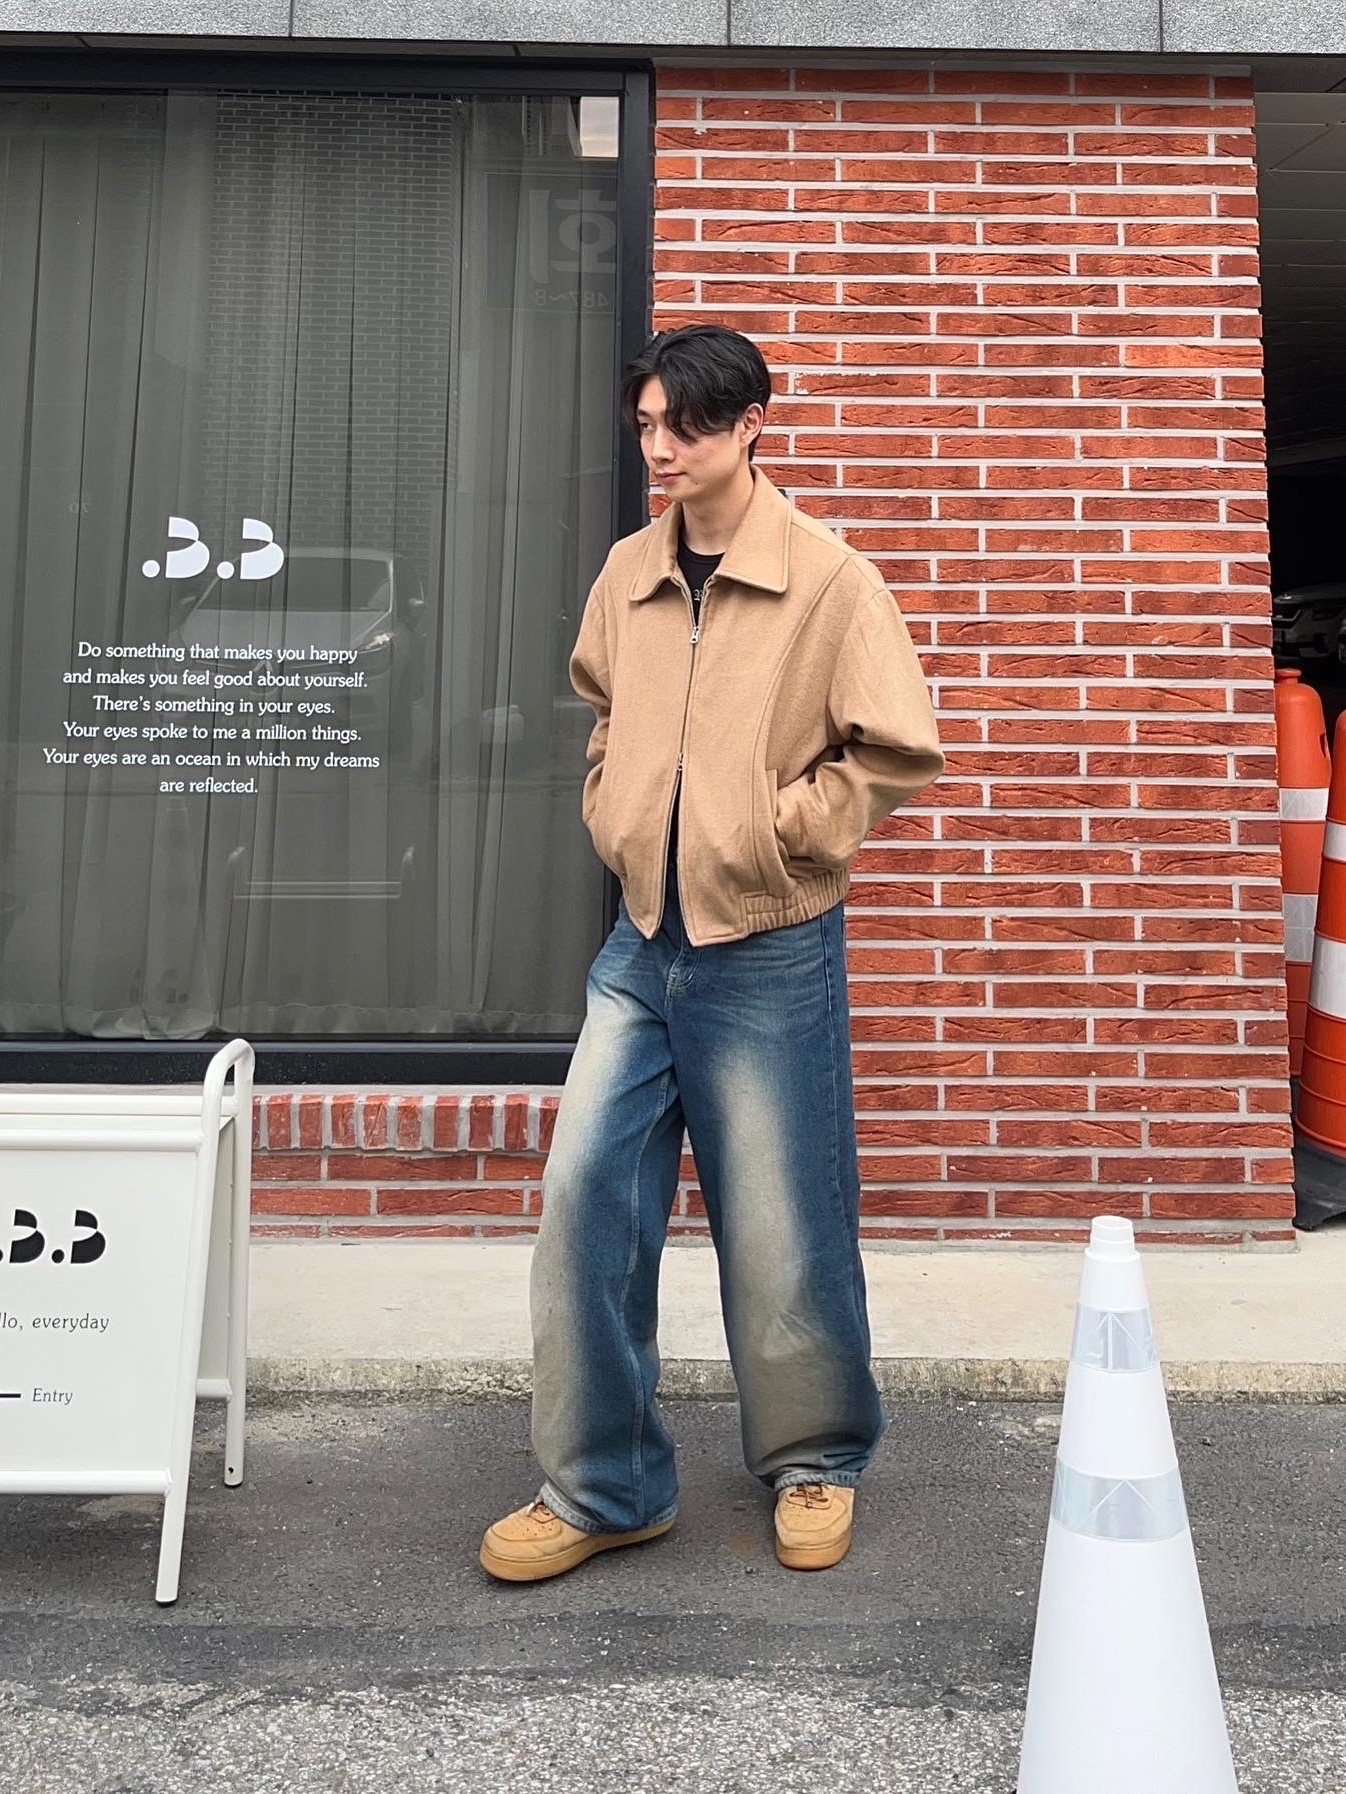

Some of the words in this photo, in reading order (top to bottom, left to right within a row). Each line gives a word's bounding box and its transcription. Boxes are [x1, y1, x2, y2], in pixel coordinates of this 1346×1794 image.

[77, 641, 102, 658] Do
[105, 642, 186, 662] something
[190, 643, 220, 659] that
[224, 646, 273, 661] makes
[276, 647, 306, 664] you
[309, 644, 358, 665] happy
[62, 667, 92, 684] and
[95, 668, 146, 685] makes
[148, 673, 178, 688] you
[182, 668, 210, 686] feel
[214, 670, 253, 689] good
[256, 668, 301, 687] about
[304, 671, 368, 691] yourself.
[92, 694, 151, 712] There's
[154, 695, 235, 716] something
[239, 698, 254, 713] in
[257, 701, 294, 717] your
[297, 702, 335, 717] eyes.
[63, 720, 101, 738] Your
[103, 726, 138, 741] eyes
[141, 722, 188, 742] spoke
[192, 724, 209, 739] to
[212, 727, 238, 740] me
[241, 728, 251, 740] a
[255, 723, 307, 741] million
[311, 724, 362, 744] things.
[42, 747, 80, 764] Your
[83, 752, 118, 768] eyes
[121, 753, 147, 765] are
[150, 754, 171, 766] an
[174, 754, 222, 766] ocean
[226, 751, 241, 766] in
[245, 750, 291, 767] which
[295, 755, 321, 771] my
[323, 751, 380, 768] dreams
[159, 781, 185, 793] are
[189, 776, 259, 794] reflected.
[32, 1313, 110, 1333] everyday
[32, 1388, 73, 1405] Entry
